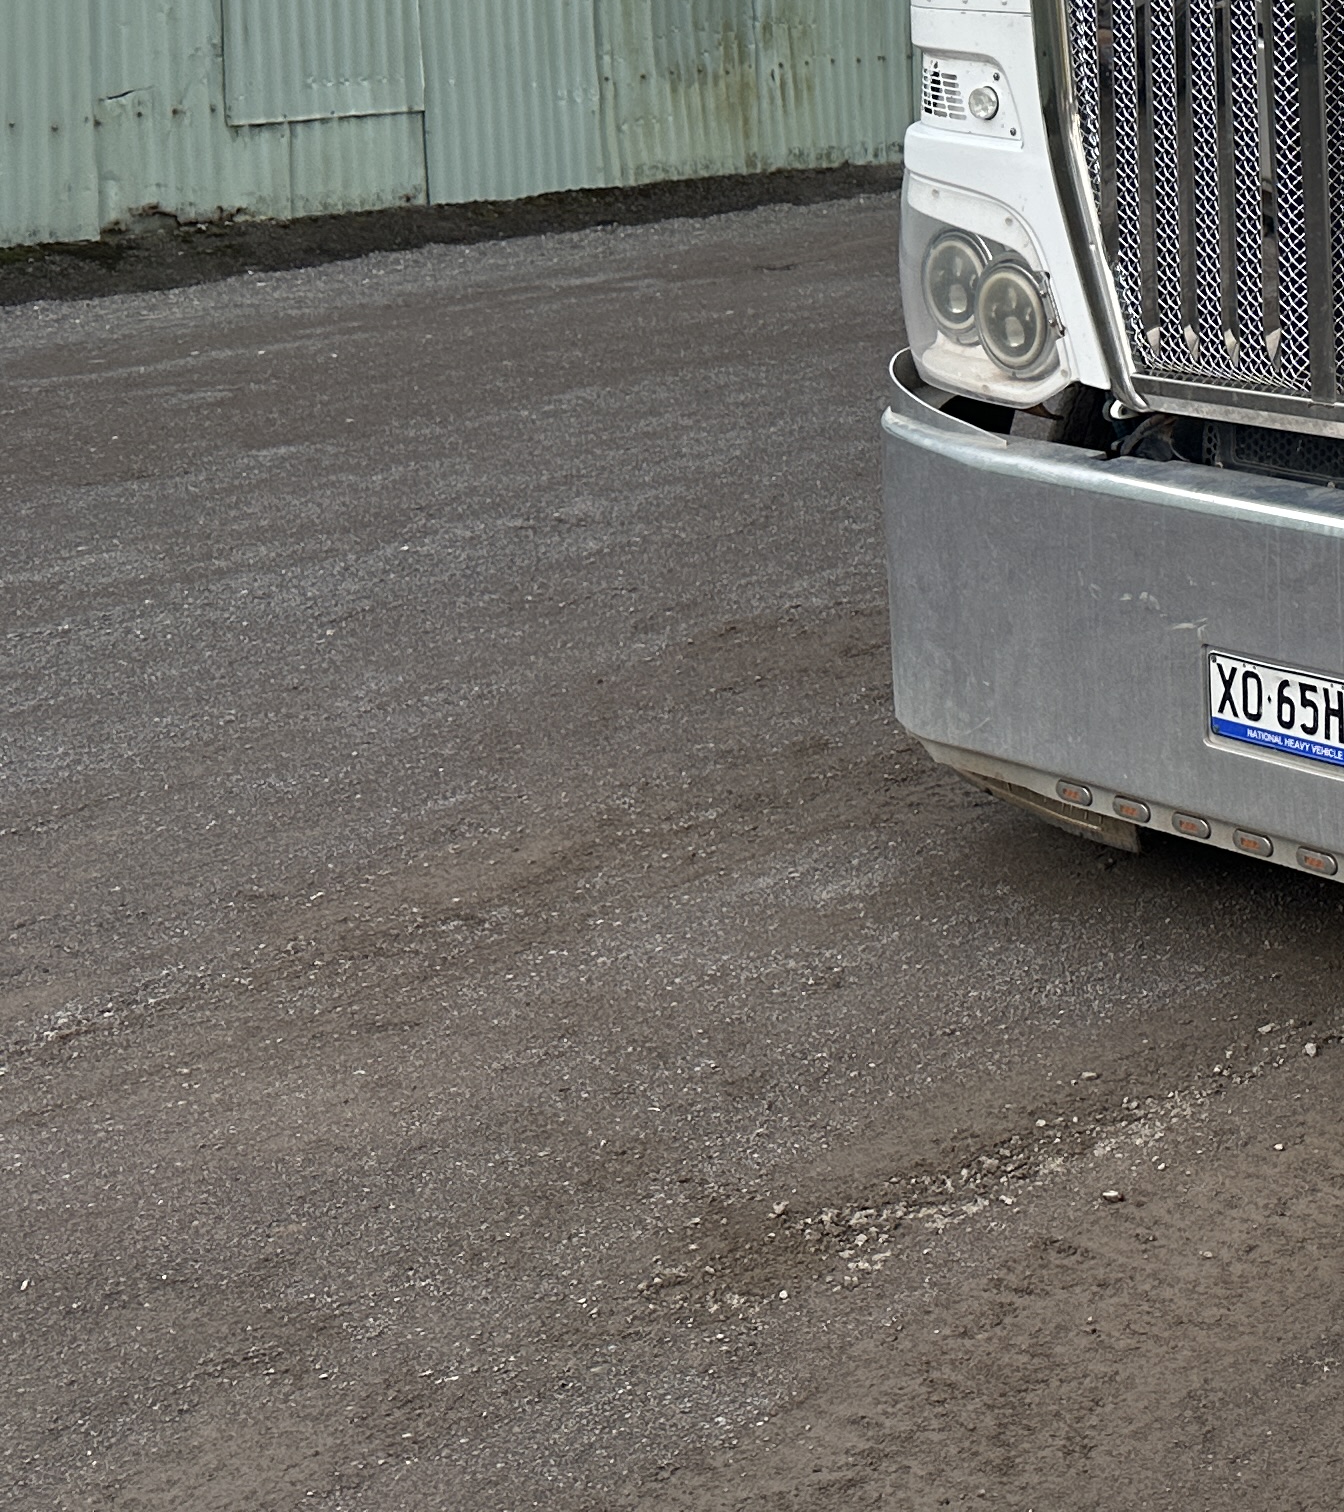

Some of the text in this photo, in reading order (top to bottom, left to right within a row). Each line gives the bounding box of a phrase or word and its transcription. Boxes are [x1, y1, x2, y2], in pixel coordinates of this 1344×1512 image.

[1246, 728, 1344, 761] NATIONAL HEAVY VEHICLE
